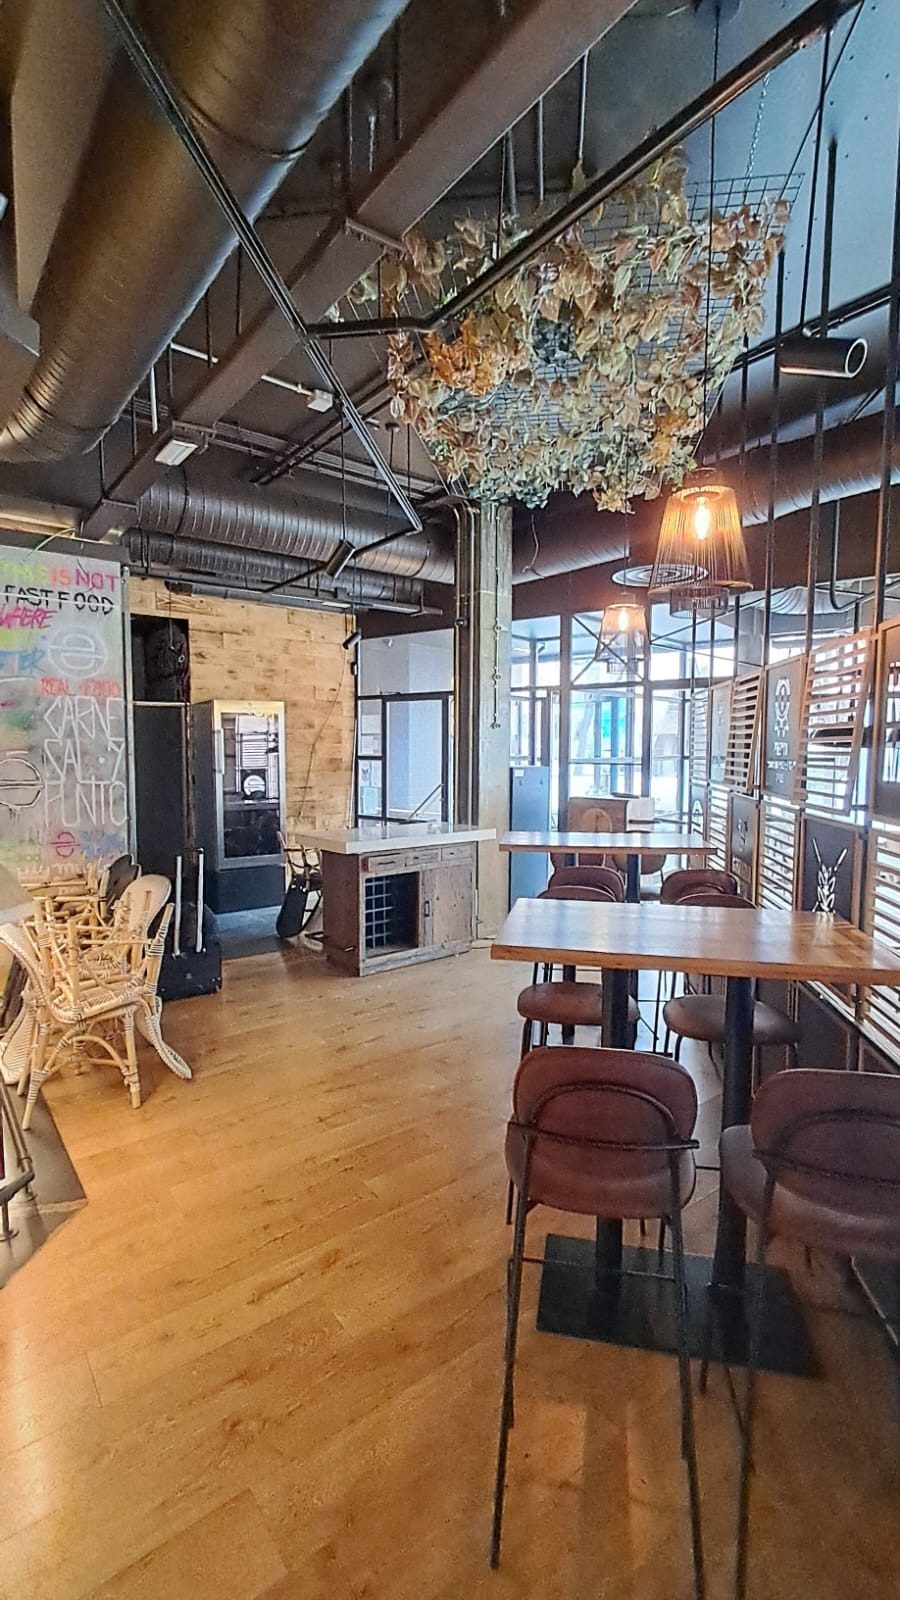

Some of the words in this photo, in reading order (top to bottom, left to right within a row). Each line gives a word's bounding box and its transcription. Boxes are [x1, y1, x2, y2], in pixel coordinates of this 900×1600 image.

[5, 585, 53, 609] FAST
[57, 591, 114, 615] FOOD
[75, 569, 119, 592] NOT
[44, 695, 126, 746] CARNE
[43, 775, 128, 829] PUNTO
